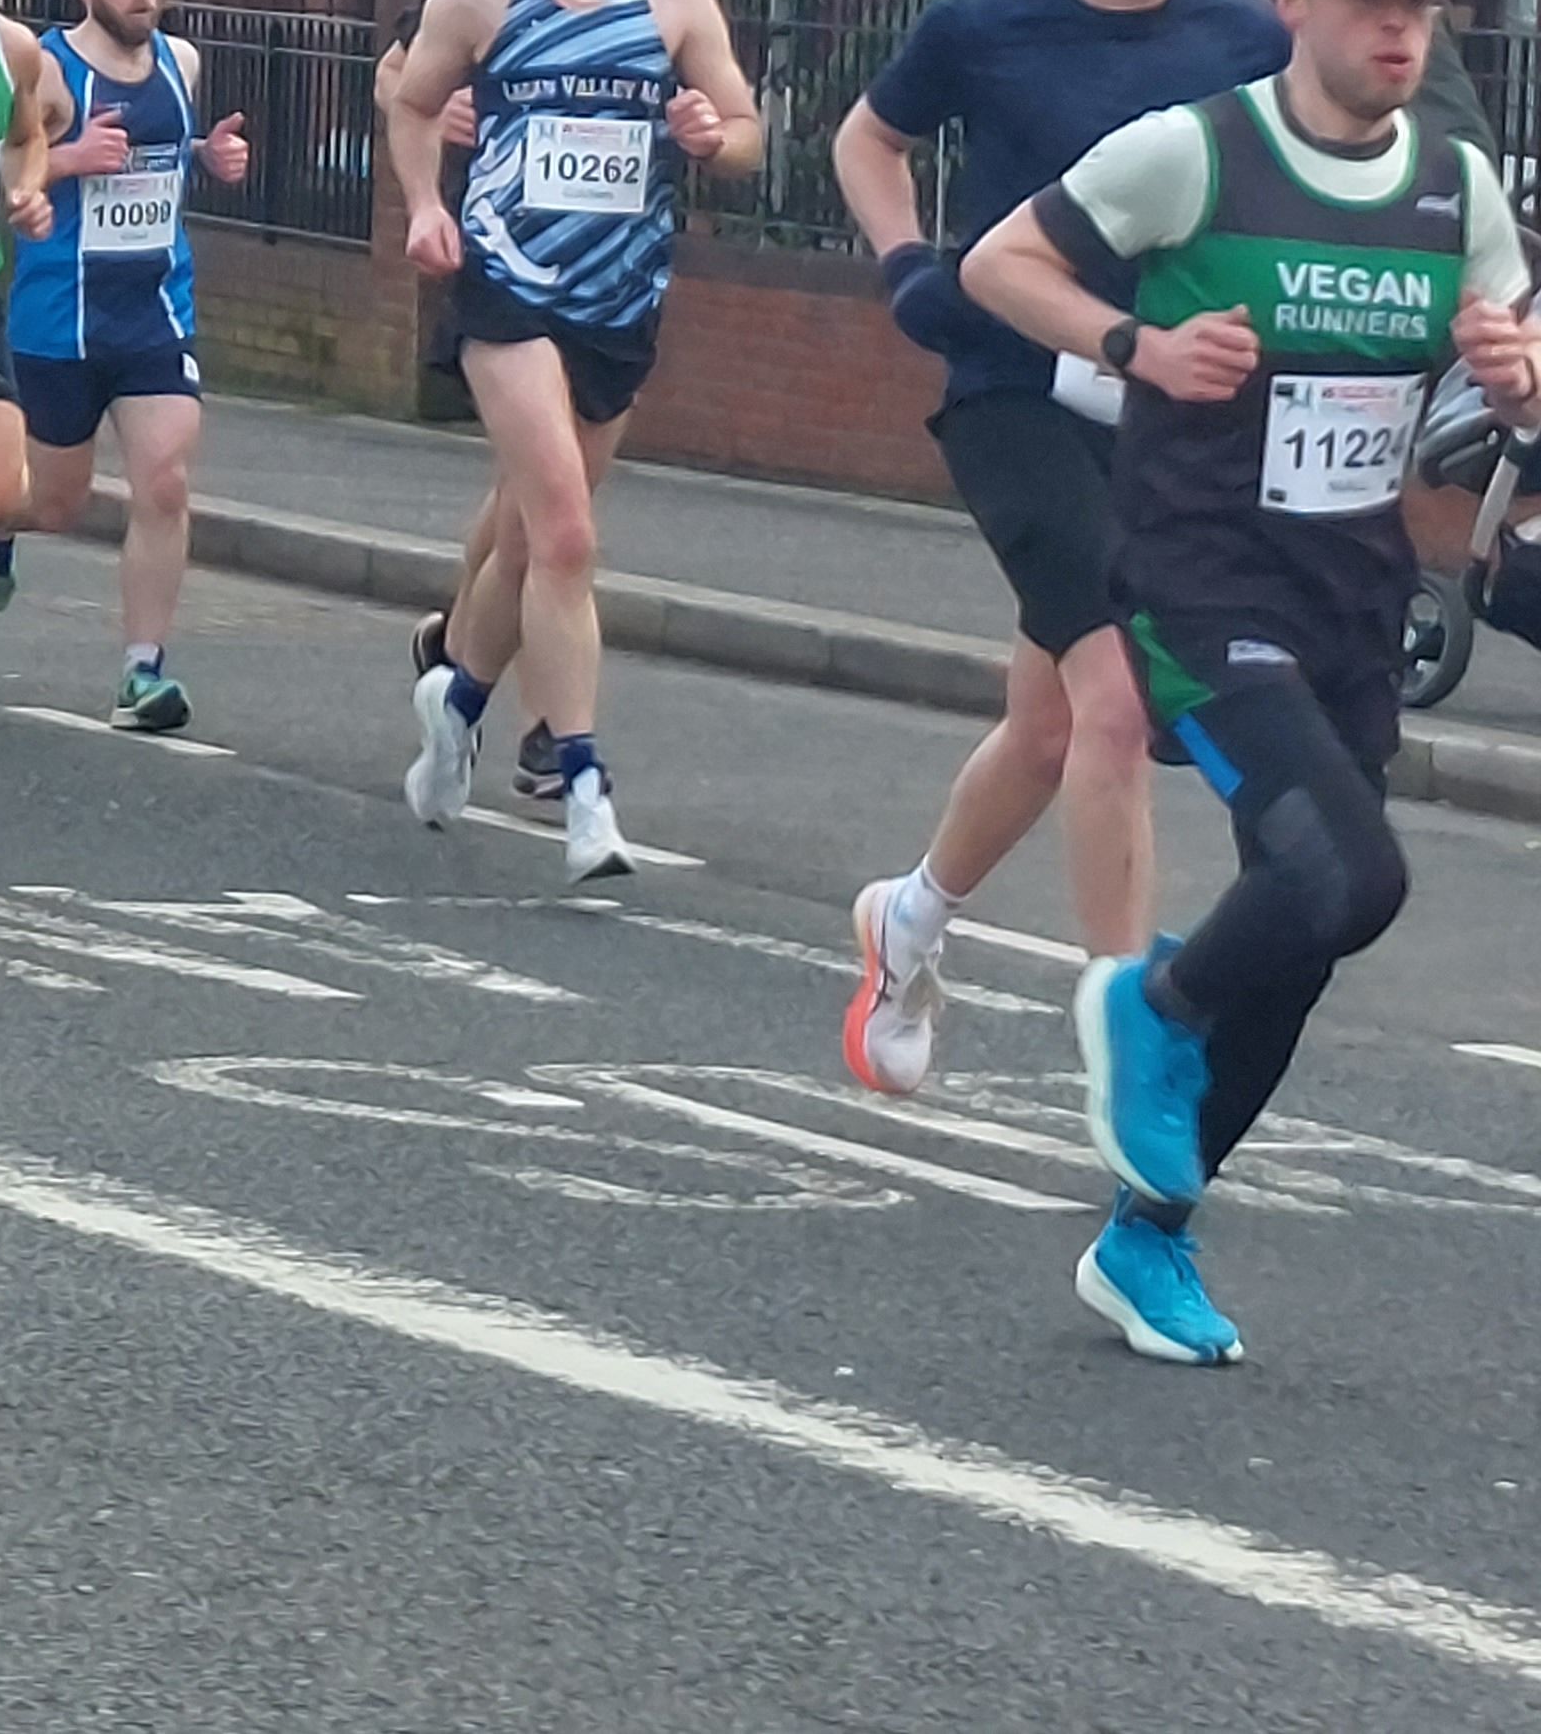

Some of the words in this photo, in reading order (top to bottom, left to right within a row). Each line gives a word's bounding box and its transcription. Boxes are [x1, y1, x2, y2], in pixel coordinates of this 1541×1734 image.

[561, 74, 637, 100] VALLEY
[537, 151, 640, 184] 10262
[1277, 262, 1431, 308] VEGAN
[1275, 303, 1427, 339] RUNNERS
